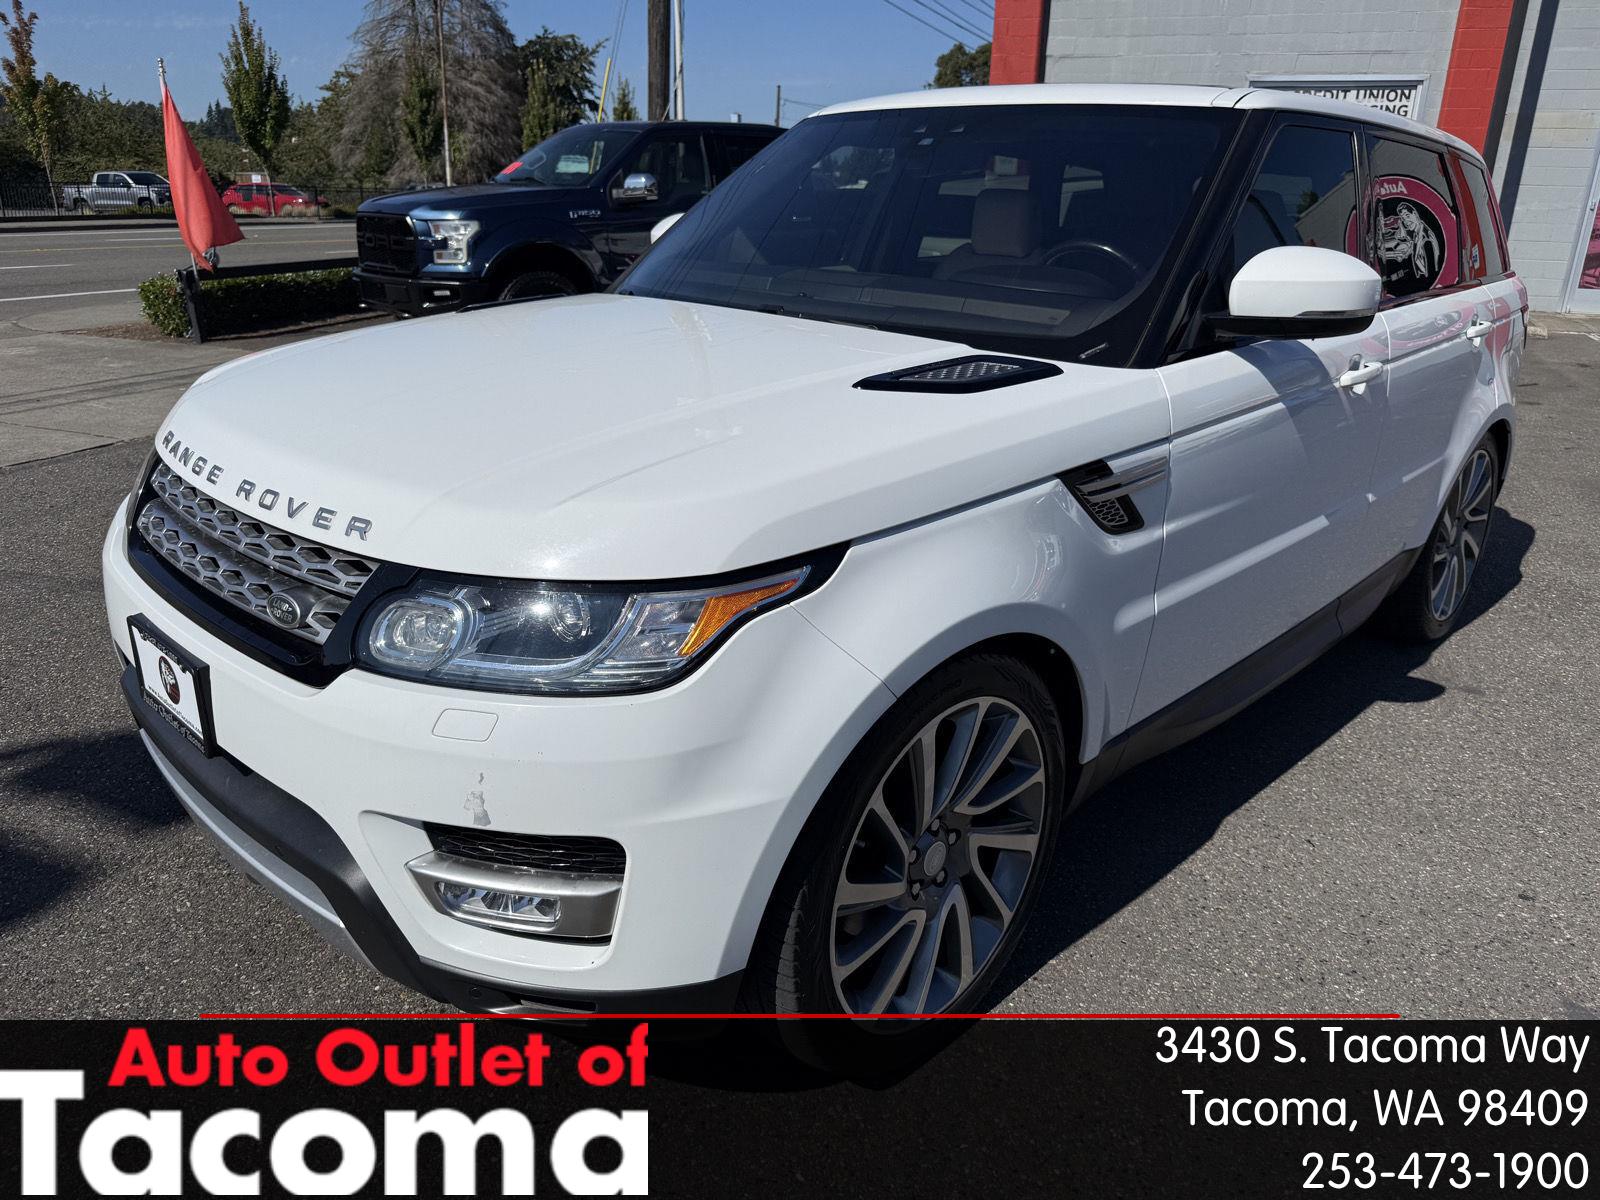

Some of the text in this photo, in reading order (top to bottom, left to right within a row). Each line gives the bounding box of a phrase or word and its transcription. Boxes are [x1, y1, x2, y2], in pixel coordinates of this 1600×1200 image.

[1355, 89, 1412, 102] UNION
[162, 430, 373, 541] RANGE ROVER
